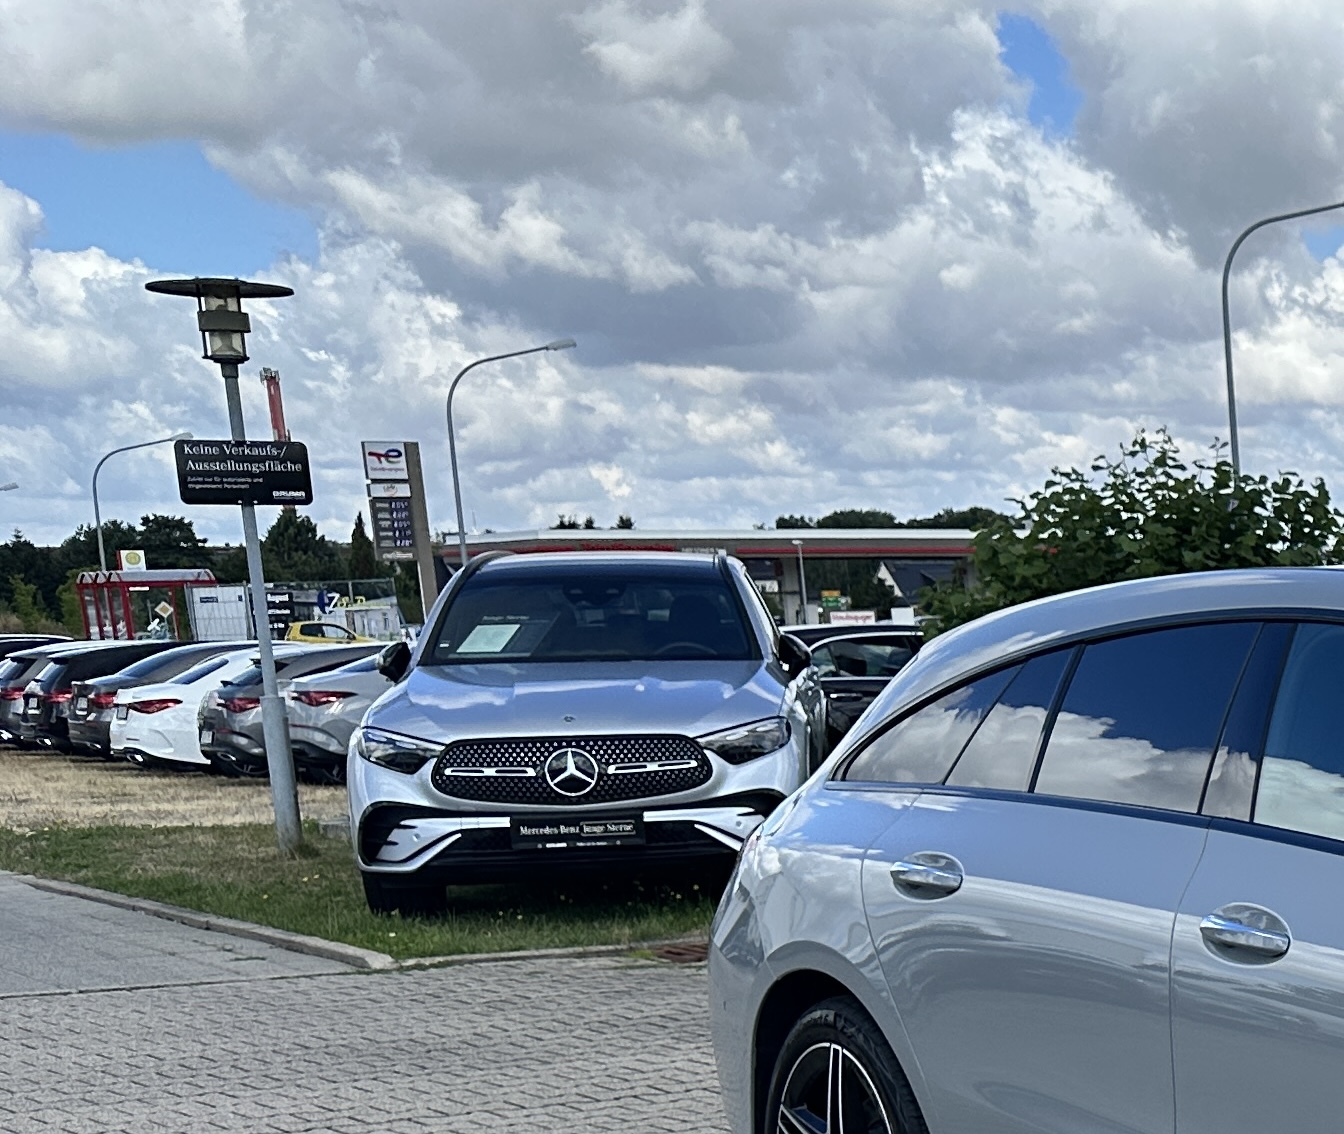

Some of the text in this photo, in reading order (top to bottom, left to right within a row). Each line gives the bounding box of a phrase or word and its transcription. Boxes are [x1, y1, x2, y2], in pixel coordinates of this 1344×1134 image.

[183, 443, 287, 458] Keine Verkaufs-/
[186, 459, 302, 473] Ausstellungsfläche
